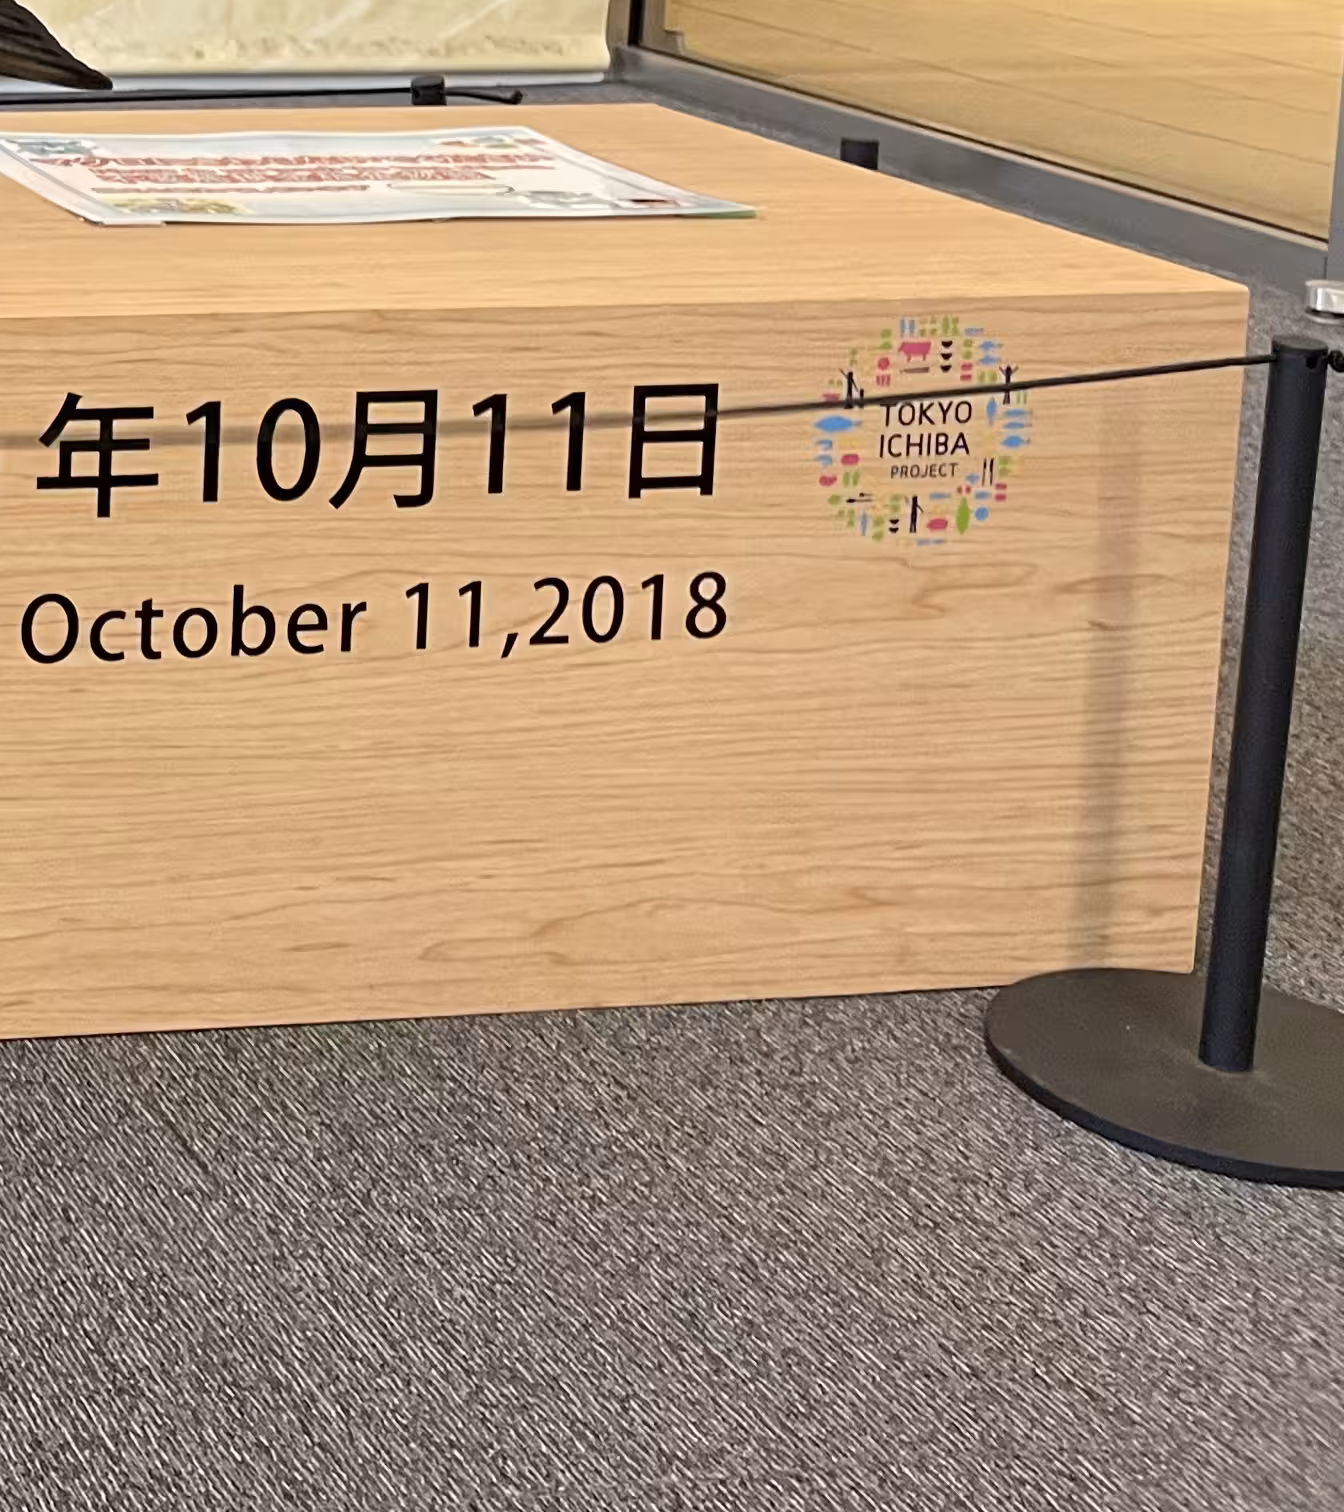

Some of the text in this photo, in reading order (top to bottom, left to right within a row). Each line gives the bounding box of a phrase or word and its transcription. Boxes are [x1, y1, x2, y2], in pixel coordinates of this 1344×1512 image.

[881, 400, 973, 427] TOKYO
[879, 432, 971, 458] ICHIBA
[889, 462, 959, 479] PROJECT
[20, 584, 368, 664] October
[405, 571, 728, 659] 11,2018
